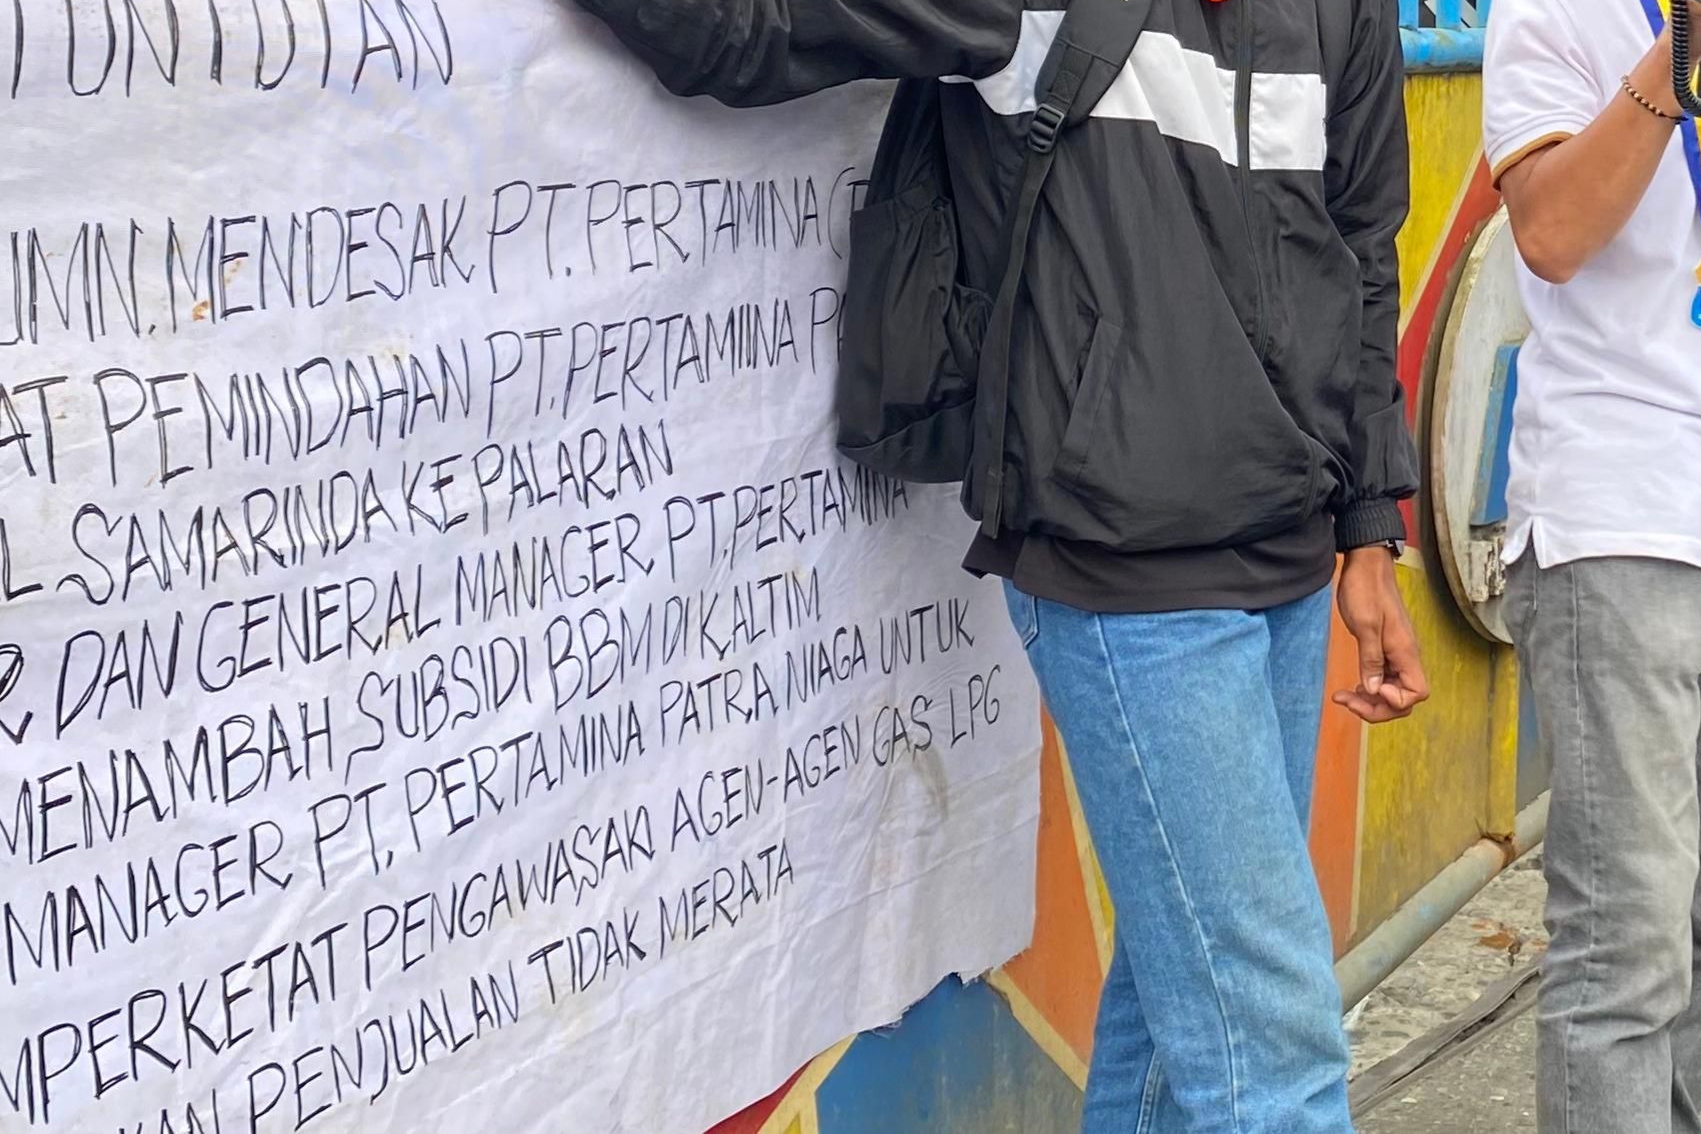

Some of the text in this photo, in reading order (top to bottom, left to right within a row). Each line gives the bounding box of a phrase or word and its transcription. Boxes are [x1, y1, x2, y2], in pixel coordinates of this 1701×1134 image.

[167, 194, 477, 334] MENDESAK
[586, 174, 822, 276] PERTAMINA
[56, 467, 399, 607] SAMARINDA
[402, 453, 469, 536] KE
[471, 418, 674, 537] PALARAN
[93, 337, 471, 489] PEMINDAHAN
[56, 610, 184, 740] DAN
[197, 563, 442, 693] GENERAL
[454, 512, 655, 626] MANAGER
[730, 463, 909, 570] PERTAMINA
[344, 635, 533, 786] SUBSIDI
[543, 602, 653, 715] BBM
[663, 596, 690, 666] DI
[700, 566, 822, 662] KALTIM
[3, 820, 293, 986] MANAGER
[404, 699, 646, 852] PERTAMINA
[660, 661, 779, 747] PATRA
[785, 624, 868, 709] NIAGA
[879, 597, 975, 677] UNTUK
[671, 714, 862, 852] AGEN-AGEN
[872, 694, 934, 768] GAS
[949, 664, 1002, 748] LPG
[247, 837, 796, 1134] PENJUALAN TIDAK MERATA
